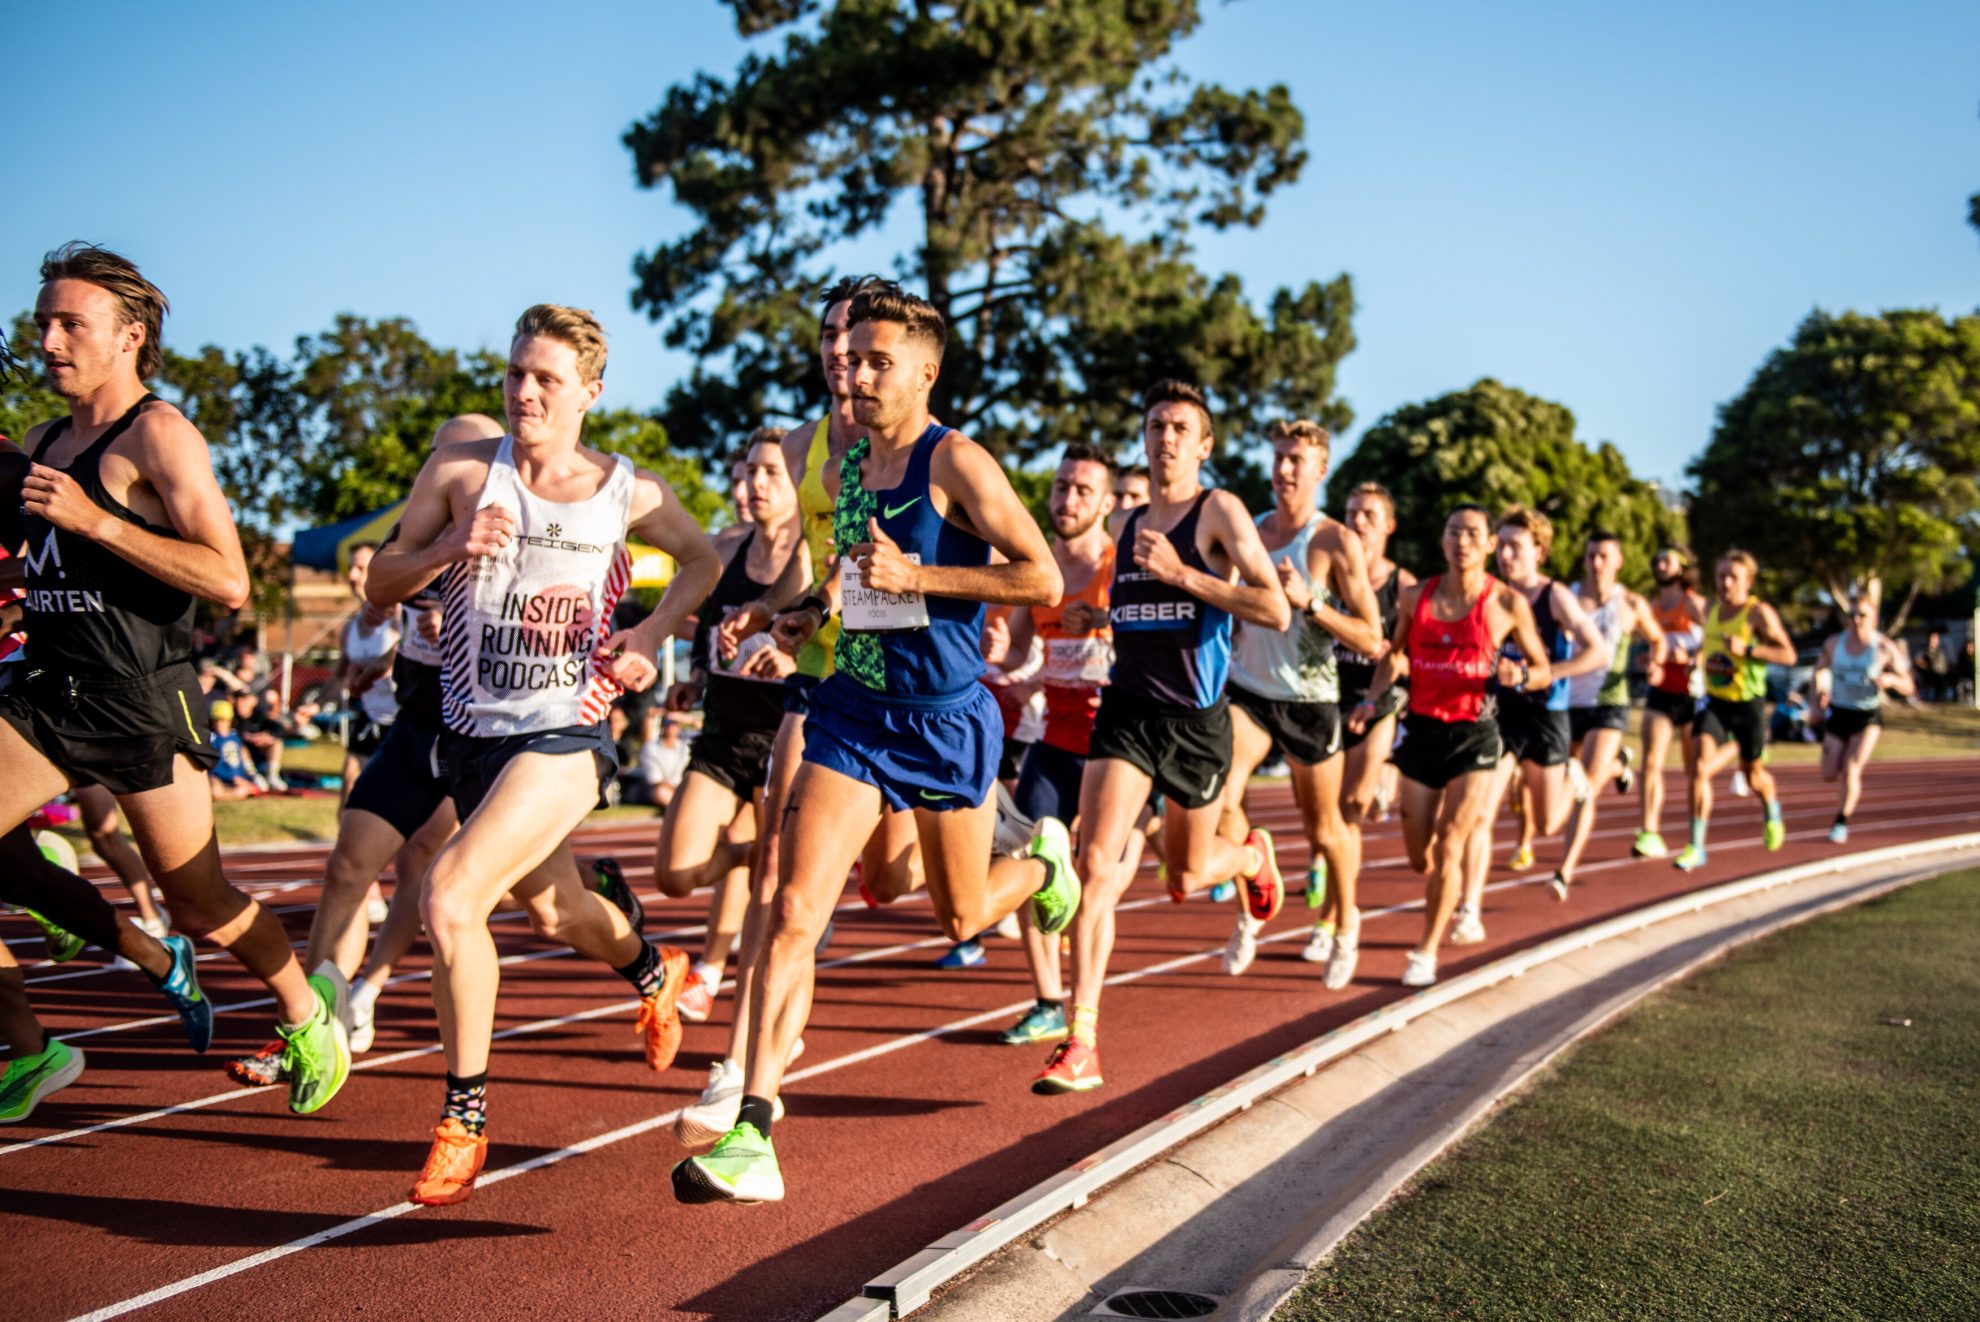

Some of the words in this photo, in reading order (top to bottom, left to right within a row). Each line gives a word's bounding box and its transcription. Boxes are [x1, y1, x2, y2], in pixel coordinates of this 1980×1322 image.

[512, 534, 604, 554] TEIGEN
[25, 589, 105, 613] AURTEN
[501, 592, 584, 624] INSIDE
[1110, 602, 1196, 623] KIESER
[481, 623, 593, 657] RUNNING
[478, 656, 587, 690] PODCAST
